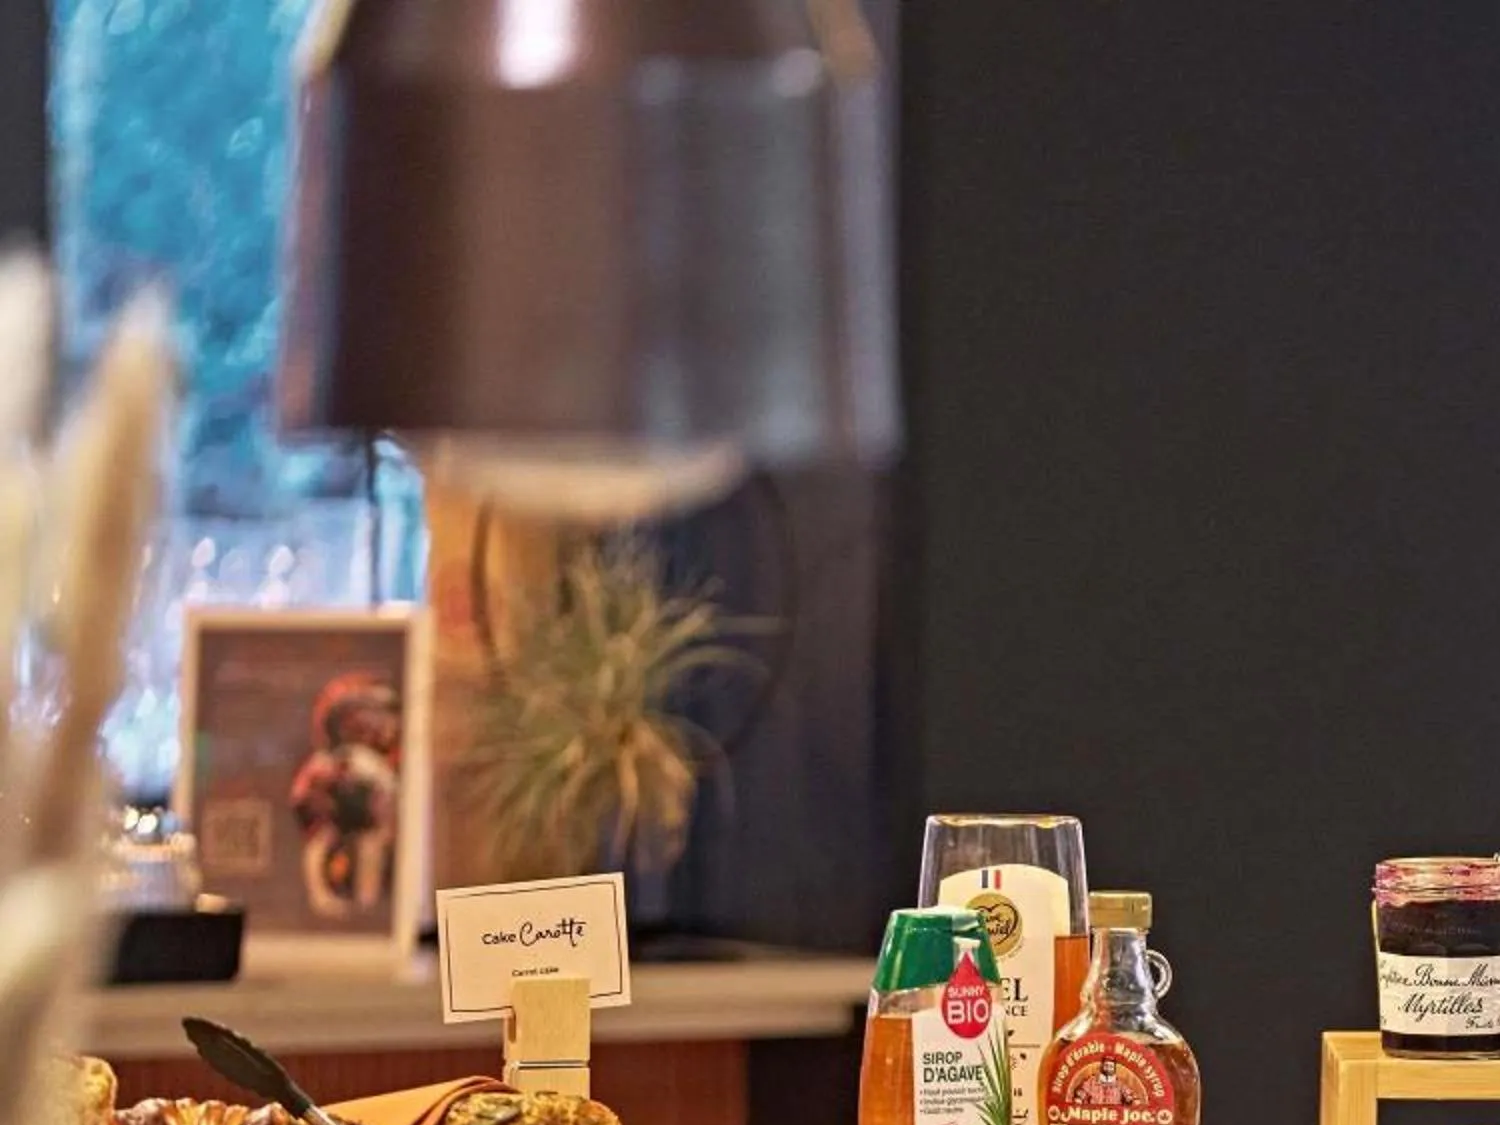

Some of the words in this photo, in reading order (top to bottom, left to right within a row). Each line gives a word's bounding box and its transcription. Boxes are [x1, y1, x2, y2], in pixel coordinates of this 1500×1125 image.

[519, 918, 587, 948] Carotte
[947, 999, 989, 1025] BIO
[1398, 992, 1483, 1022] Myrtilles
[922, 1051, 963, 1065] SIROP
[923, 1065, 985, 1083] D'AGAVE
[1061, 1106, 1118, 1124] Maple
